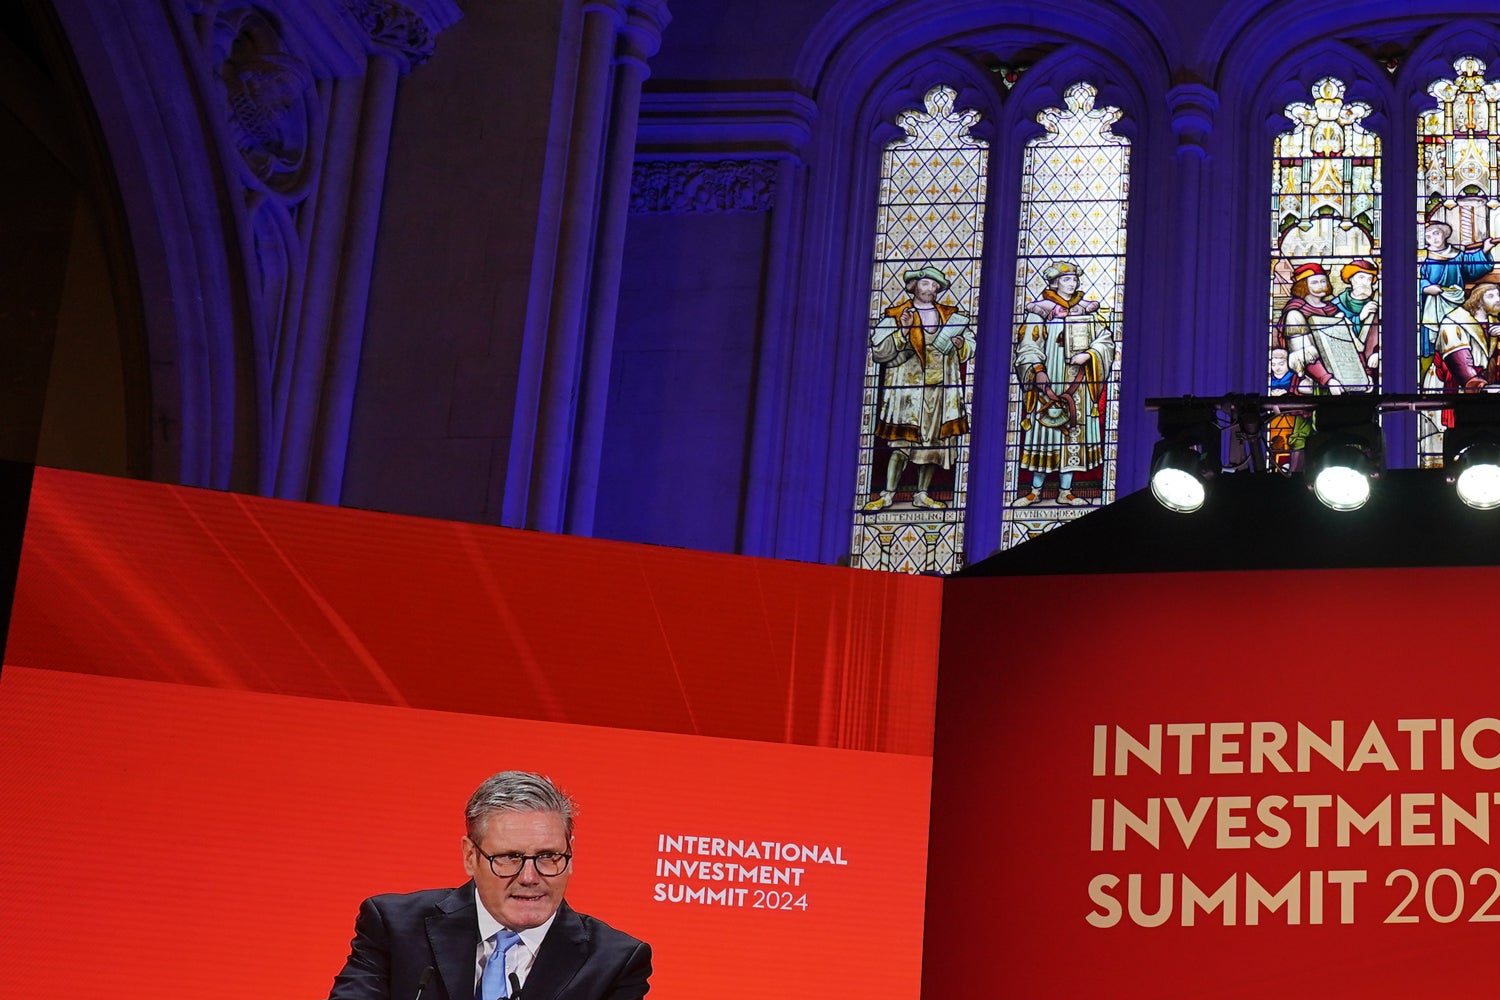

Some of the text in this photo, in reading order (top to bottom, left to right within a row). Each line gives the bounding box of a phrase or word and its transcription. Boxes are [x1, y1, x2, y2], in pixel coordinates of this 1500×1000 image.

[877, 512, 942, 520] GUTENBERG
[1014, 509, 1057, 518] WYNKYN
[658, 834, 848, 866] INTERNATIONAL
[656, 858, 805, 886] INVESTMENT
[653, 883, 809, 911] SUMMIT 2024
[1085, 869, 1367, 928] SUMMIT
